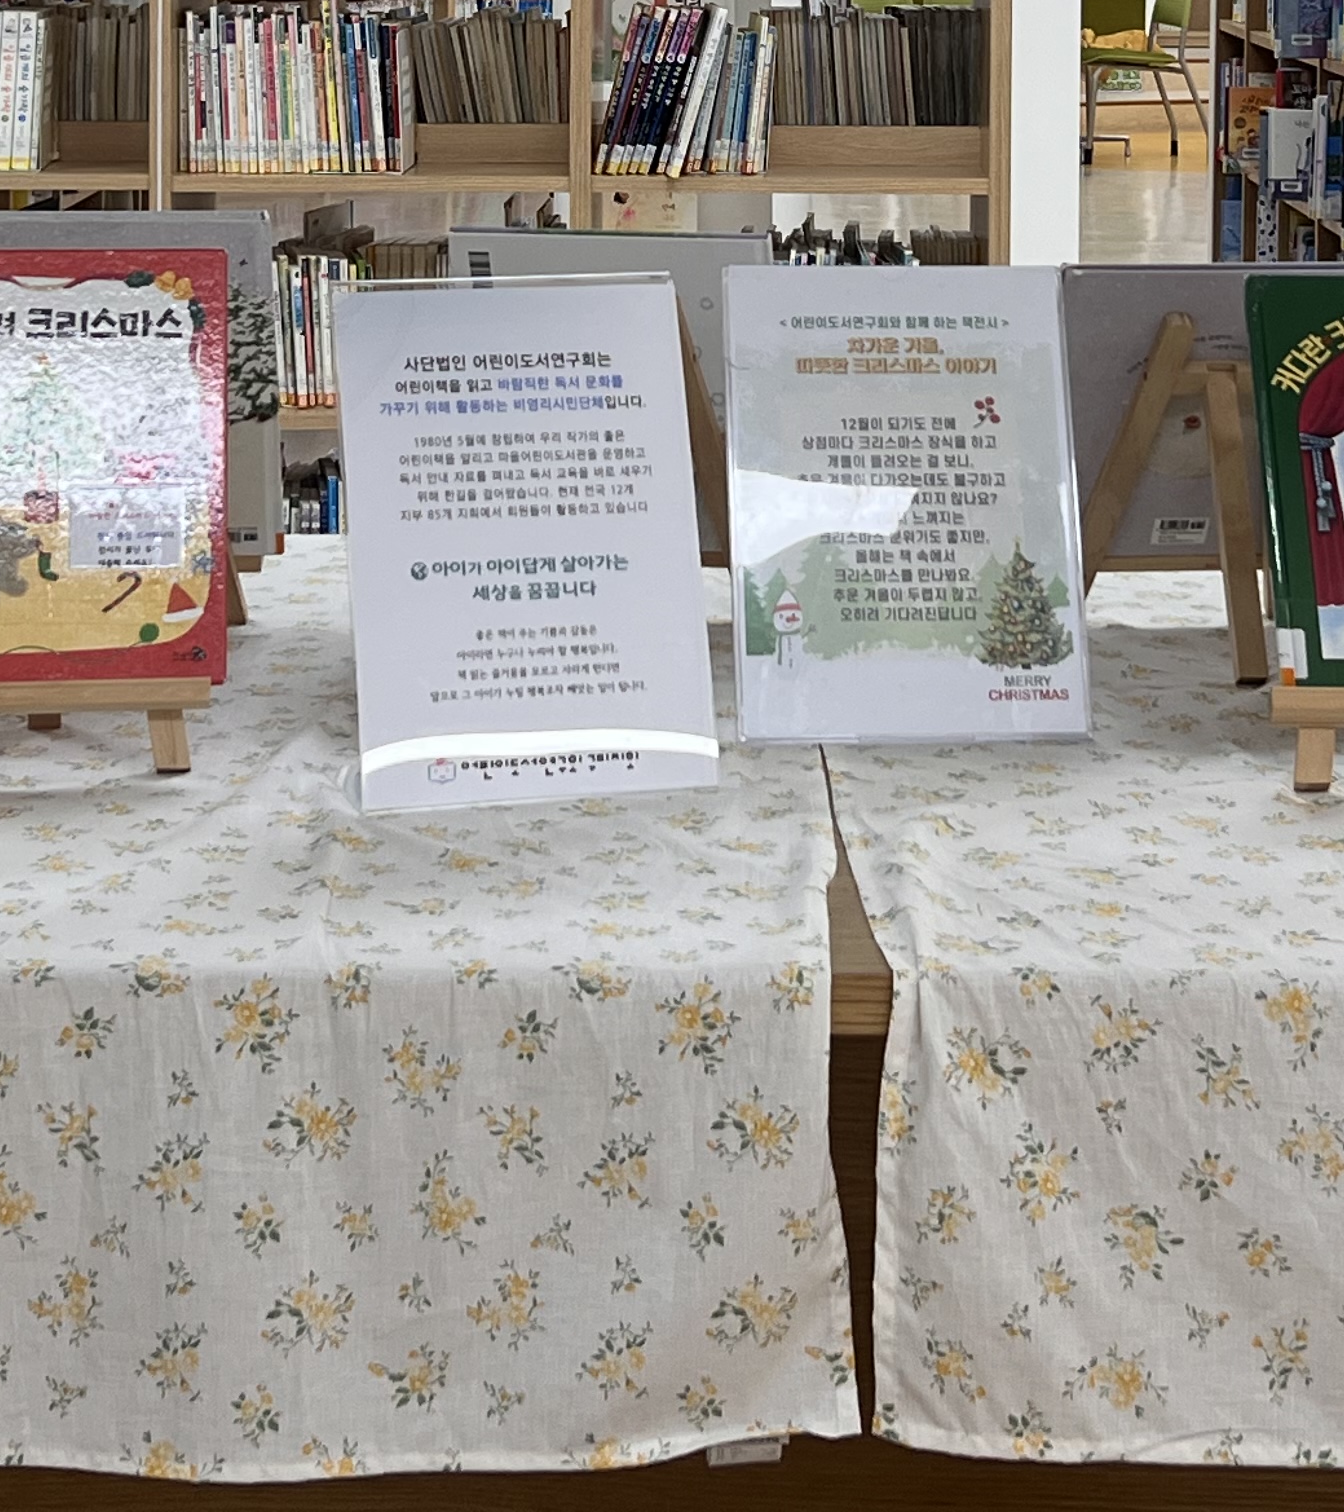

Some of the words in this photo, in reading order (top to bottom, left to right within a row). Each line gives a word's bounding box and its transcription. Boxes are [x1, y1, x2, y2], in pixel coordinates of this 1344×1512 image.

[25, 307, 183, 338] 크리스마스
[791, 317, 901, 330] 어린이도서연구회와
[934, 317, 956, 330] 하는
[847, 338, 899, 354] 차가운
[404, 355, 466, 372] 사단법인
[473, 352, 611, 369] 어린이도서연구회는
[796, 358, 848, 375] 따뜻한
[852, 358, 941, 375] 크리스마스
[945, 357, 997, 374] 이야기
[1271, 334, 1332, 394] 커다란
[395, 379, 461, 394] 어린이책을
[466, 378, 492, 392] 읽고
[498, 376, 549, 391] 바람직한
[555, 375, 580, 389] 독서
[585, 374, 623, 389] 문화를
[379, 402, 419, 416] 가꾸기
[425, 401, 450, 414] 위해
[456, 399, 508, 414] 활동하는
[513, 395, 646, 412] 비영리시민단체입니다.
[841, 417, 883, 431] 12월이
[888, 417, 926, 431] 되기도
[931, 417, 956, 431] 전에
[414, 435, 452, 448] 1980년
[457, 434, 486, 447] 5월에
[540, 432, 561, 444] 우리
[567, 430, 599, 443] 작가의
[802, 435, 854, 450] 상점마다
[858, 435, 923, 450] 크리스마스
[928, 435, 966, 450] 장식을
[971, 435, 997, 449] 하고
[399, 453, 455, 467] 어린이책을
[603, 447, 646, 460] 운영하고
[870, 454, 923, 468] 들려오는
[870, 473, 948, 486] 다가오는데도
[954, 473, 1005, 486] 불구하고
[417, 490, 439, 503] 위해
[556, 502, 600, 516] 활동하고
[856, 549, 894, 563] 올해는
[917, 549, 955, 563] 속에서
[432, 559, 482, 577] 아이가
[487, 556, 556, 575] 아이답게
[560, 553, 629, 573] 살아가는
[835, 569, 912, 582] 크리스마스를
[472, 583, 522, 602] 세상을
[834, 588, 859, 602] 추운
[864, 588, 902, 602] 겨울이
[841, 608, 879, 621] 오히려
[1003, 675, 1051, 687] MERRY
[988, 689, 1069, 701] CHRISTMAS
